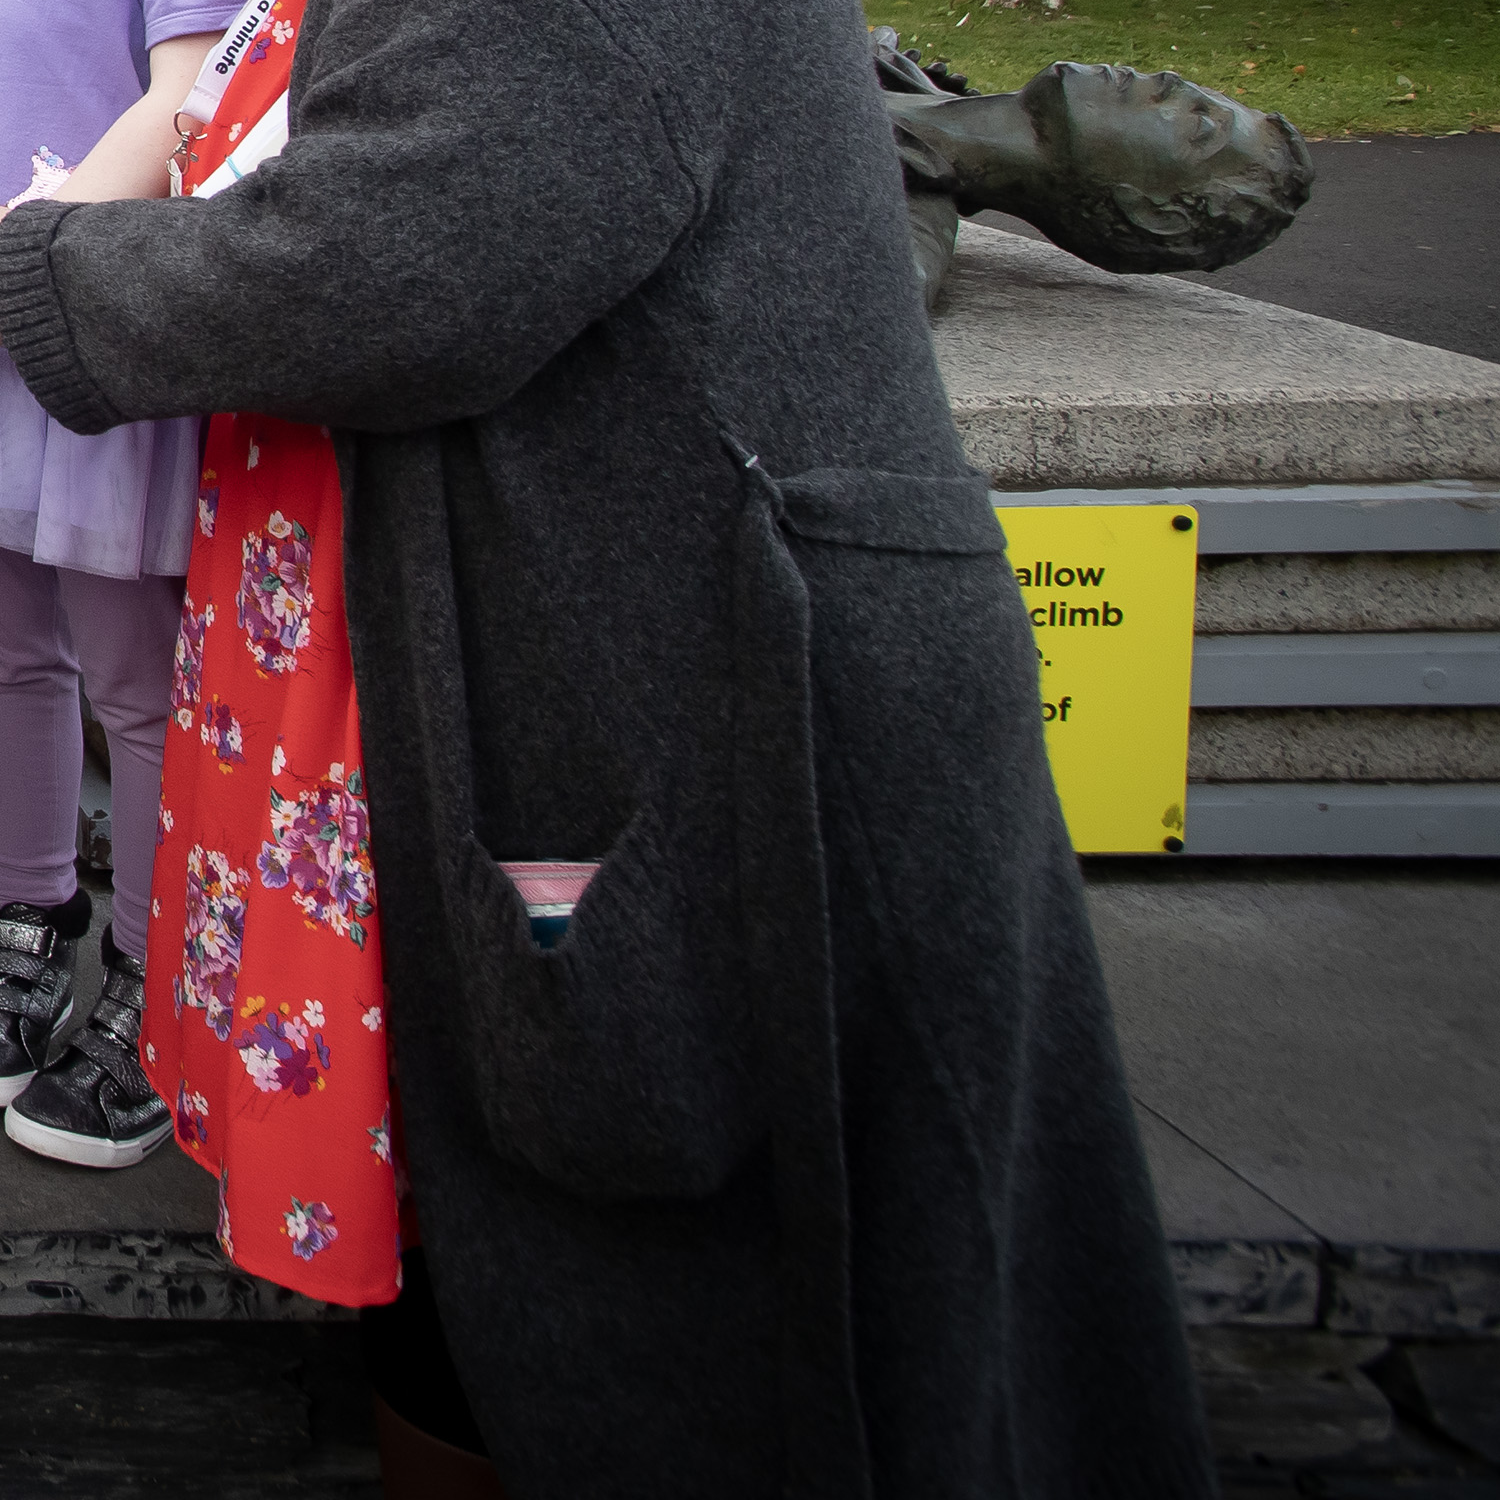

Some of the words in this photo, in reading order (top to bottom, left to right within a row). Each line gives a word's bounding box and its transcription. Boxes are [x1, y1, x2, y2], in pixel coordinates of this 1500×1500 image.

[257, 0, 270, 13] a
[215, 15, 260, 74] minute
[1015, 562, 1105, 587] allow
[1030, 602, 1123, 627] climb
